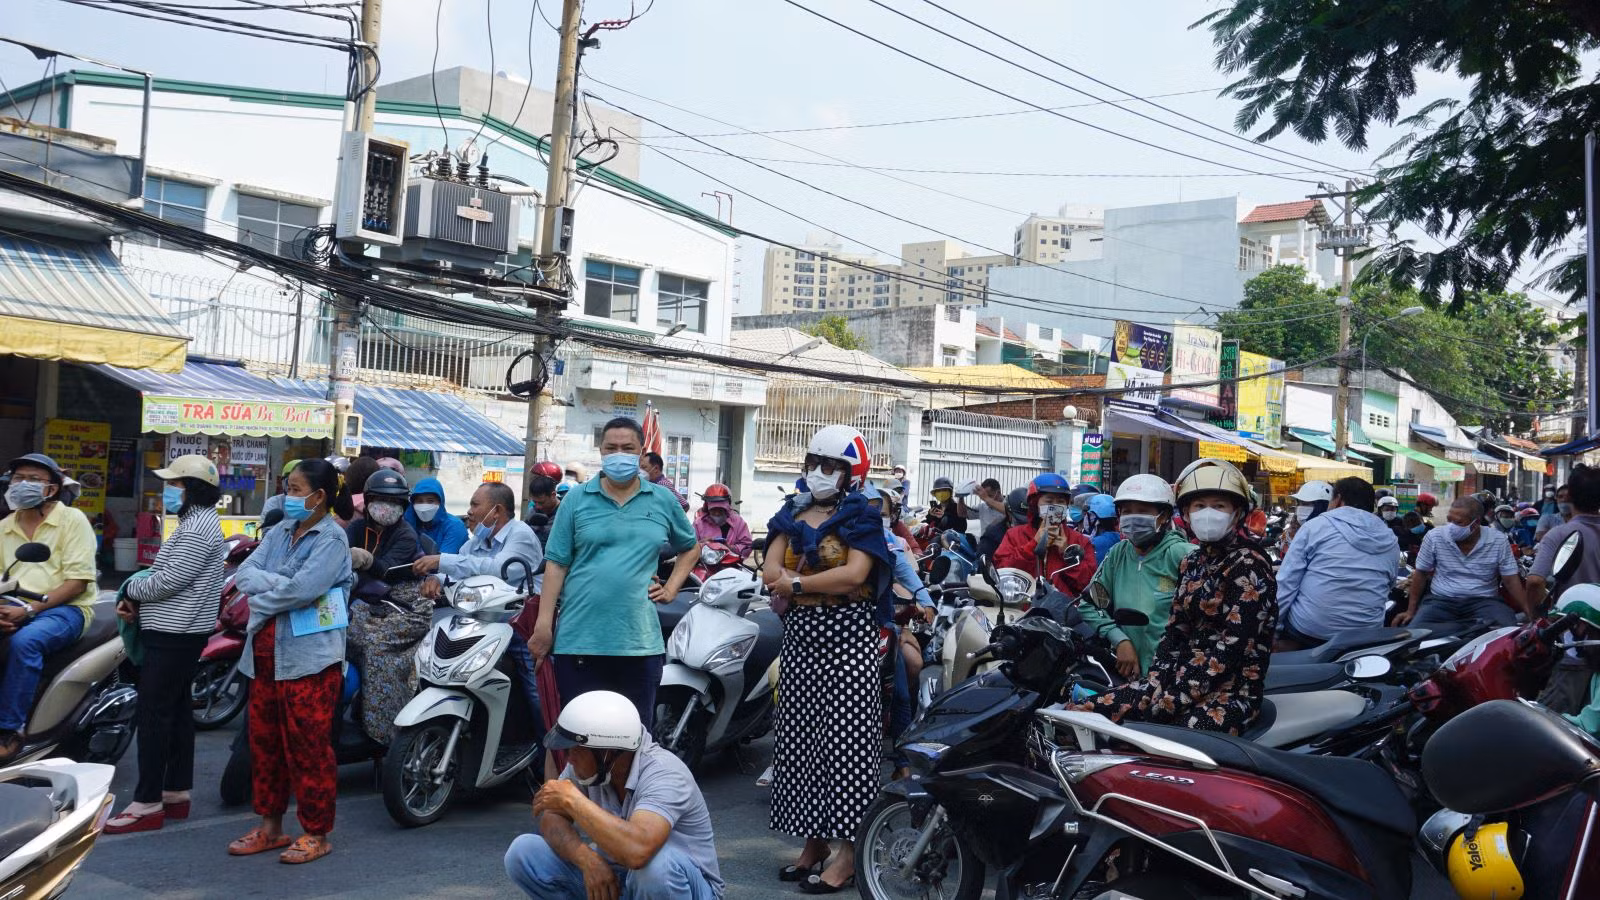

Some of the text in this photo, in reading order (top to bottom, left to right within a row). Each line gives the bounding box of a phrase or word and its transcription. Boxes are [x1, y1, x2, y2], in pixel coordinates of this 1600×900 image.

[183, 400, 214, 420] TRÀ
[221, 402, 252, 420] SỮA
[232, 439, 267, 449] TRÀ CHANH
[1129, 770, 1195, 784] LEAD
[1467, 842, 1484, 872] Yale
